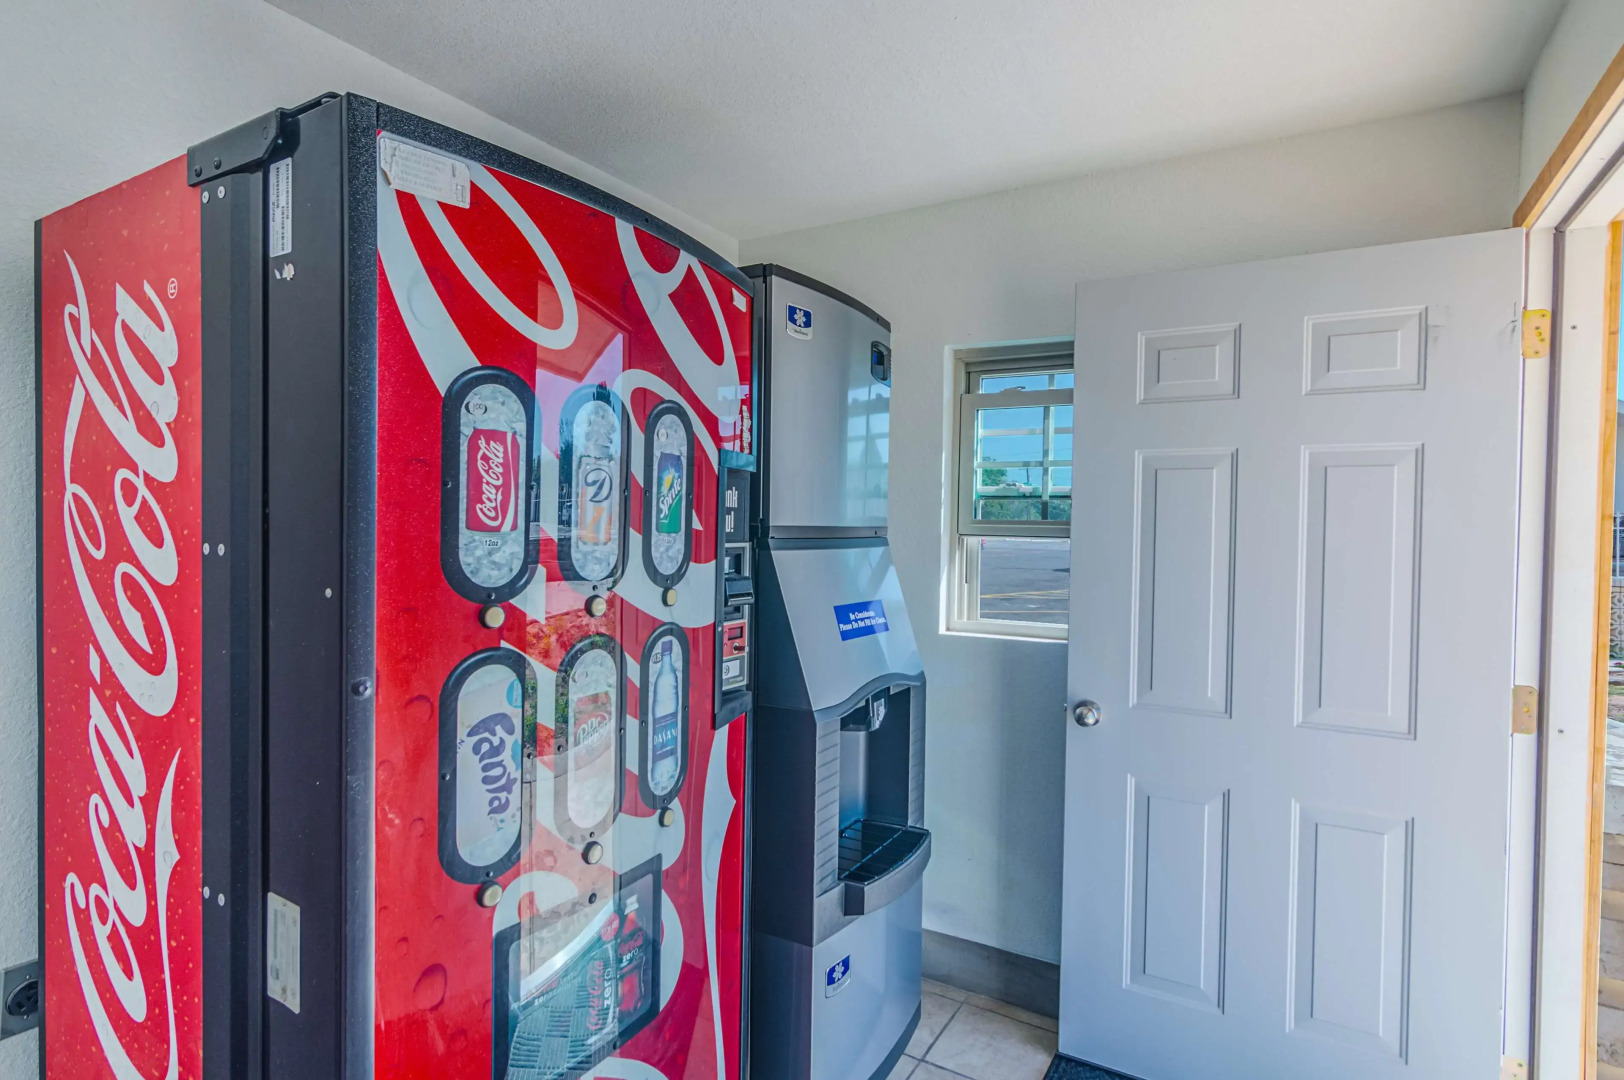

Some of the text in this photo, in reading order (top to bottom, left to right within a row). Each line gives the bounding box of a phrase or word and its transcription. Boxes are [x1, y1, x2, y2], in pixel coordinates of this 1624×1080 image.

[476, 435, 504, 527] Coca-Cola
[658, 477, 682, 519] Sprite
[484, 539, 499, 547] 12oz
[839, 623, 852, 631] Please
[852, 621, 858, 629] Do
[64, 249, 180, 1080] Coca-Cola
[653, 727, 678, 746] DASANI
[466, 712, 518, 816] Fanta
[603, 968, 612, 1008] zero
